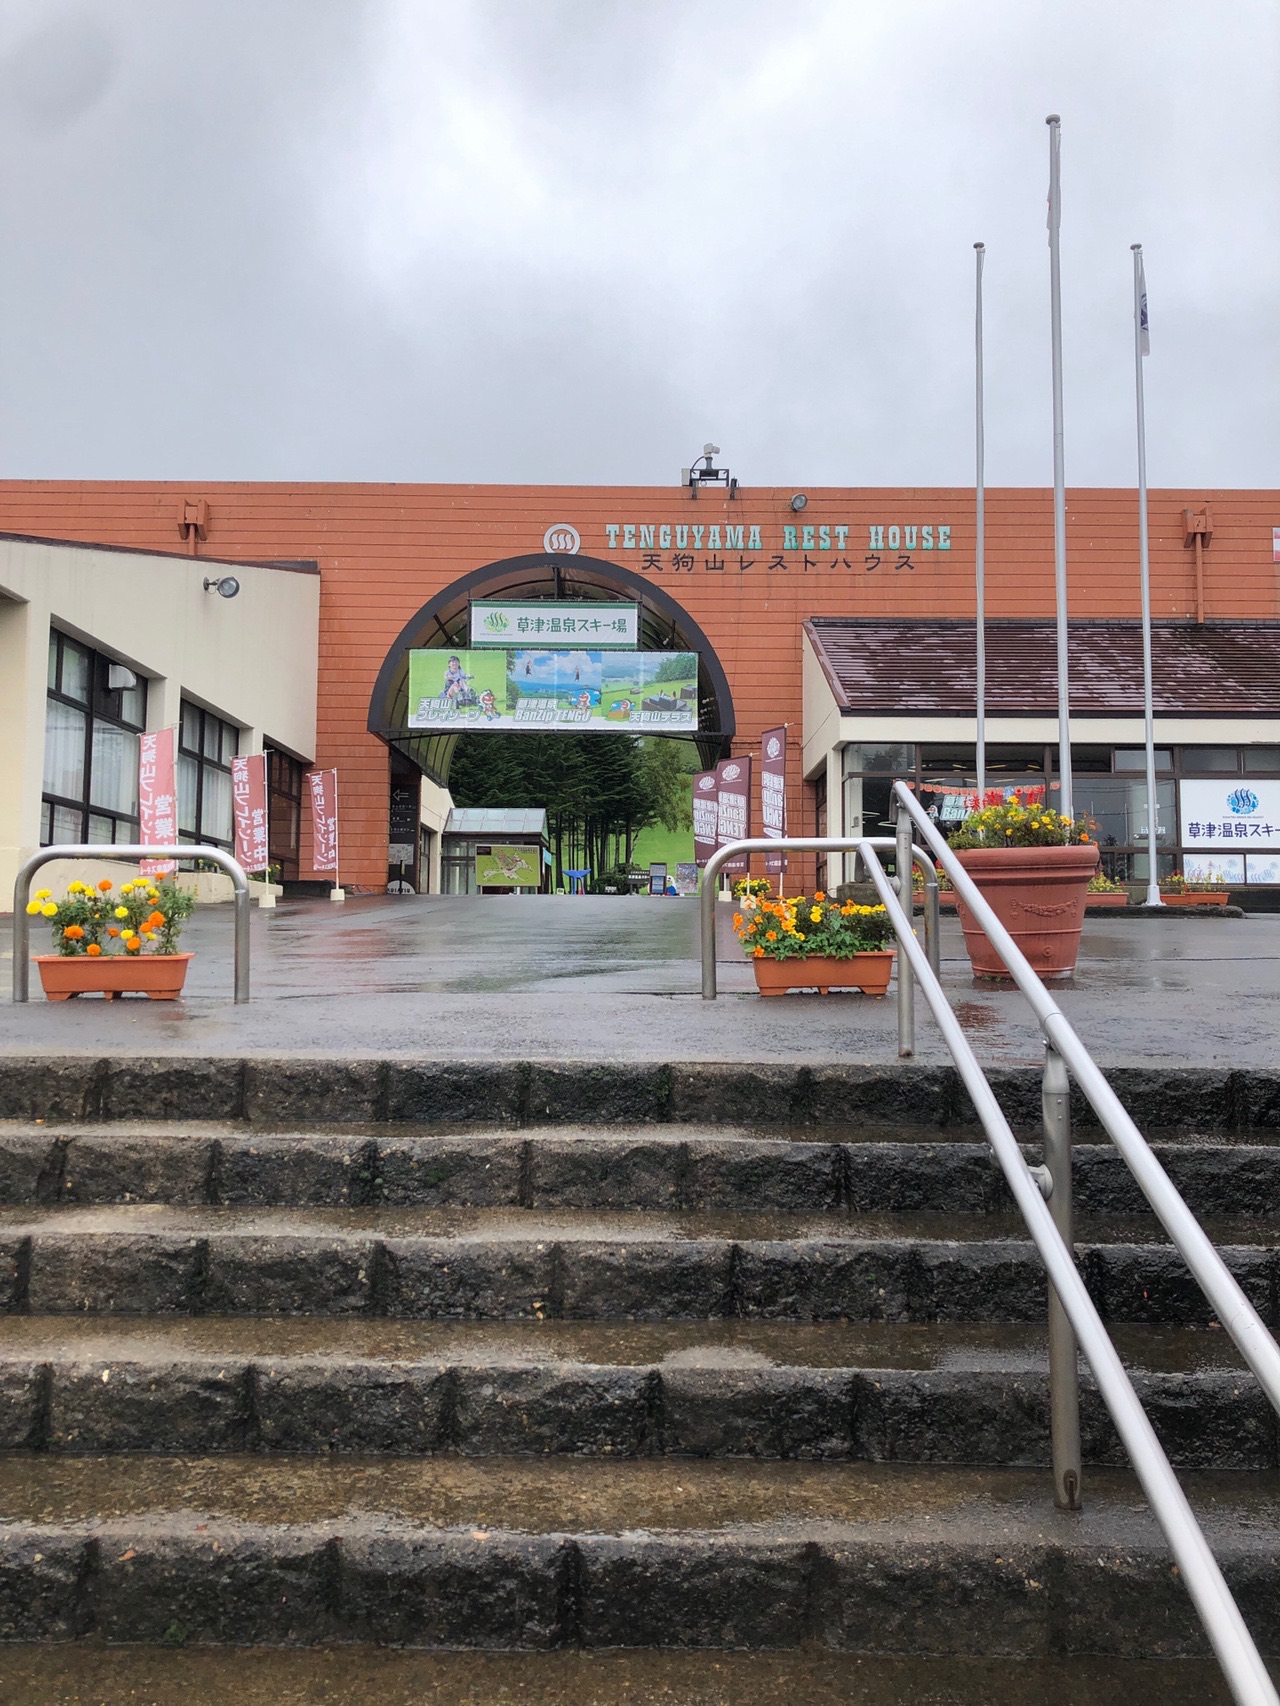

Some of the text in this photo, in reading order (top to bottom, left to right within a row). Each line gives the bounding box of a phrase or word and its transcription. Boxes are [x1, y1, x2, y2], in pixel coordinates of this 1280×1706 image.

[605, 524, 952, 550] TENGUYAMA REST HOUSE
[641, 553, 916, 572] 天狗山レストハウス
[516, 616, 627, 633] 草津温泉スキー場
[514, 709, 592, 723] BanZip TENGU
[629, 711, 692, 723] 天狗山テラス
